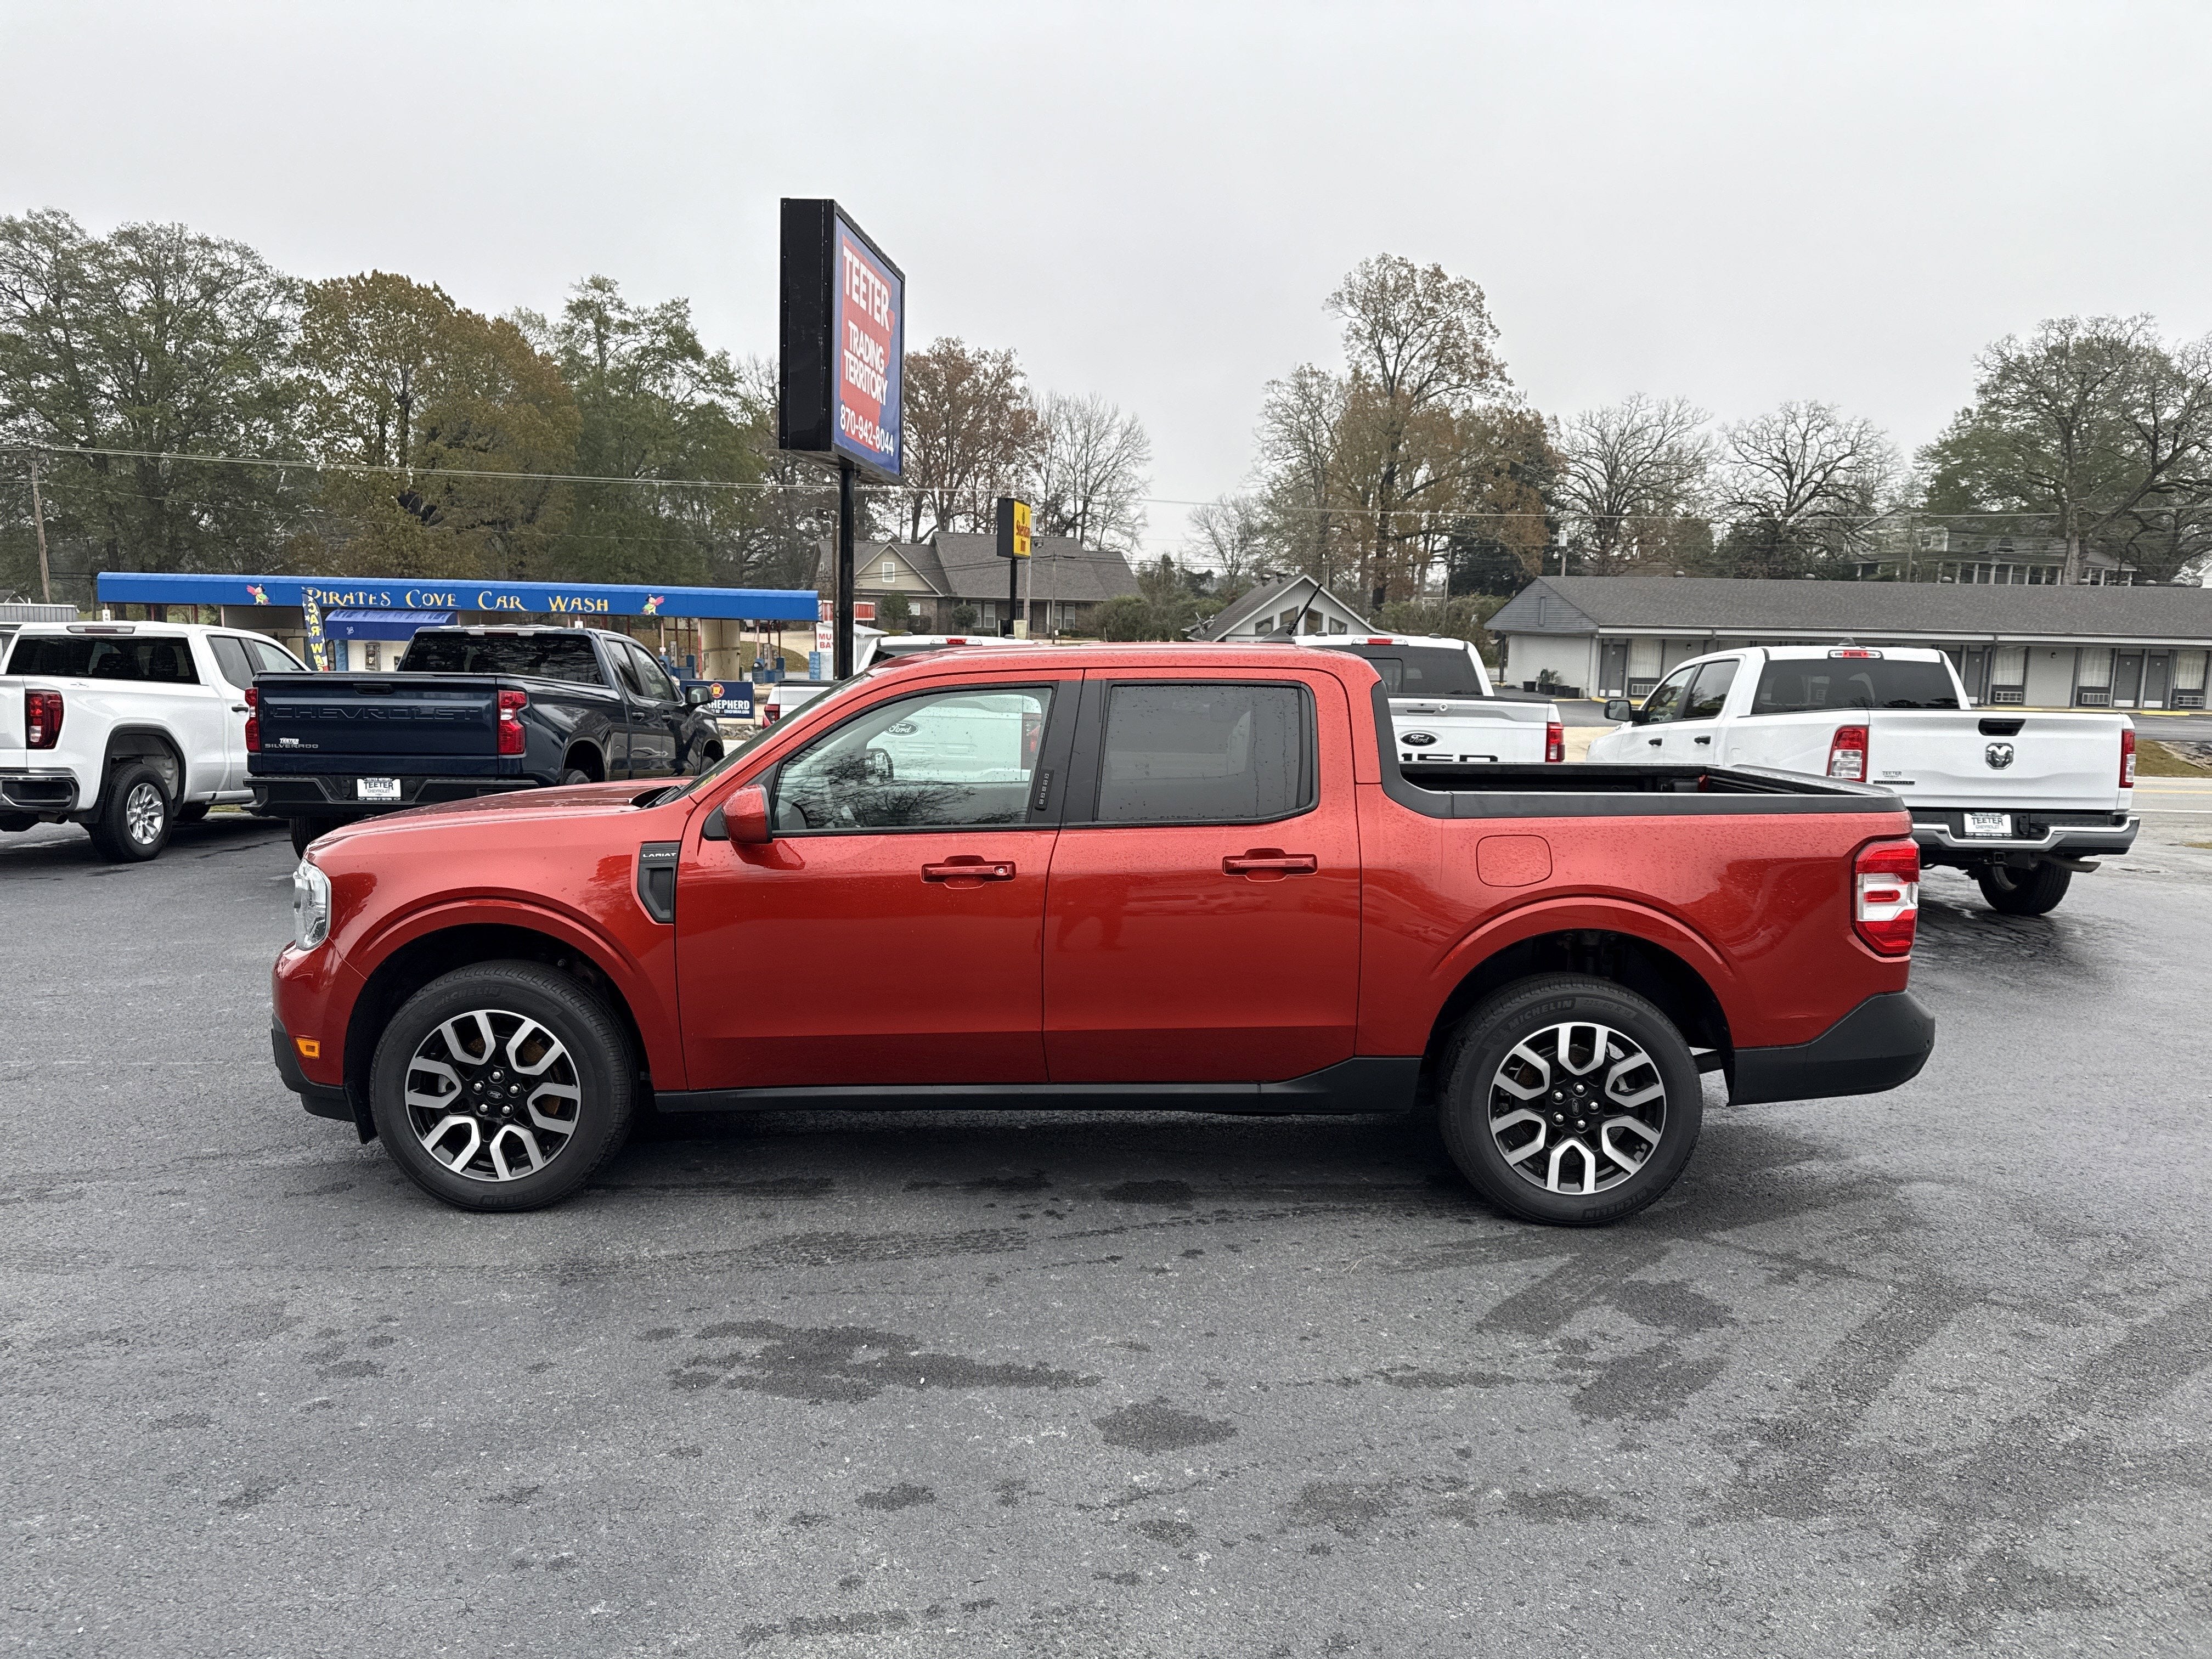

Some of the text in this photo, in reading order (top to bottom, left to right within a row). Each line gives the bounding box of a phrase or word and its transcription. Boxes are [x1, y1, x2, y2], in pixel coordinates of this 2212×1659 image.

[843, 246, 890, 331] TEETER
[848, 320, 884, 375] TRADING
[844, 349, 888, 405] TERRITORY
[840, 404, 894, 456] 870-942-8044
[548, 595, 609, 612] WASH
[273, 707, 478, 720] CHEVROLET
[889, 723, 912, 733] Ford
[364, 781, 394, 790] TEETER
[1971, 817, 2004, 826] TEETER
[435, 987, 500, 1007] MICHELIN
[1508, 1000, 1572, 1030] MICHELIN
